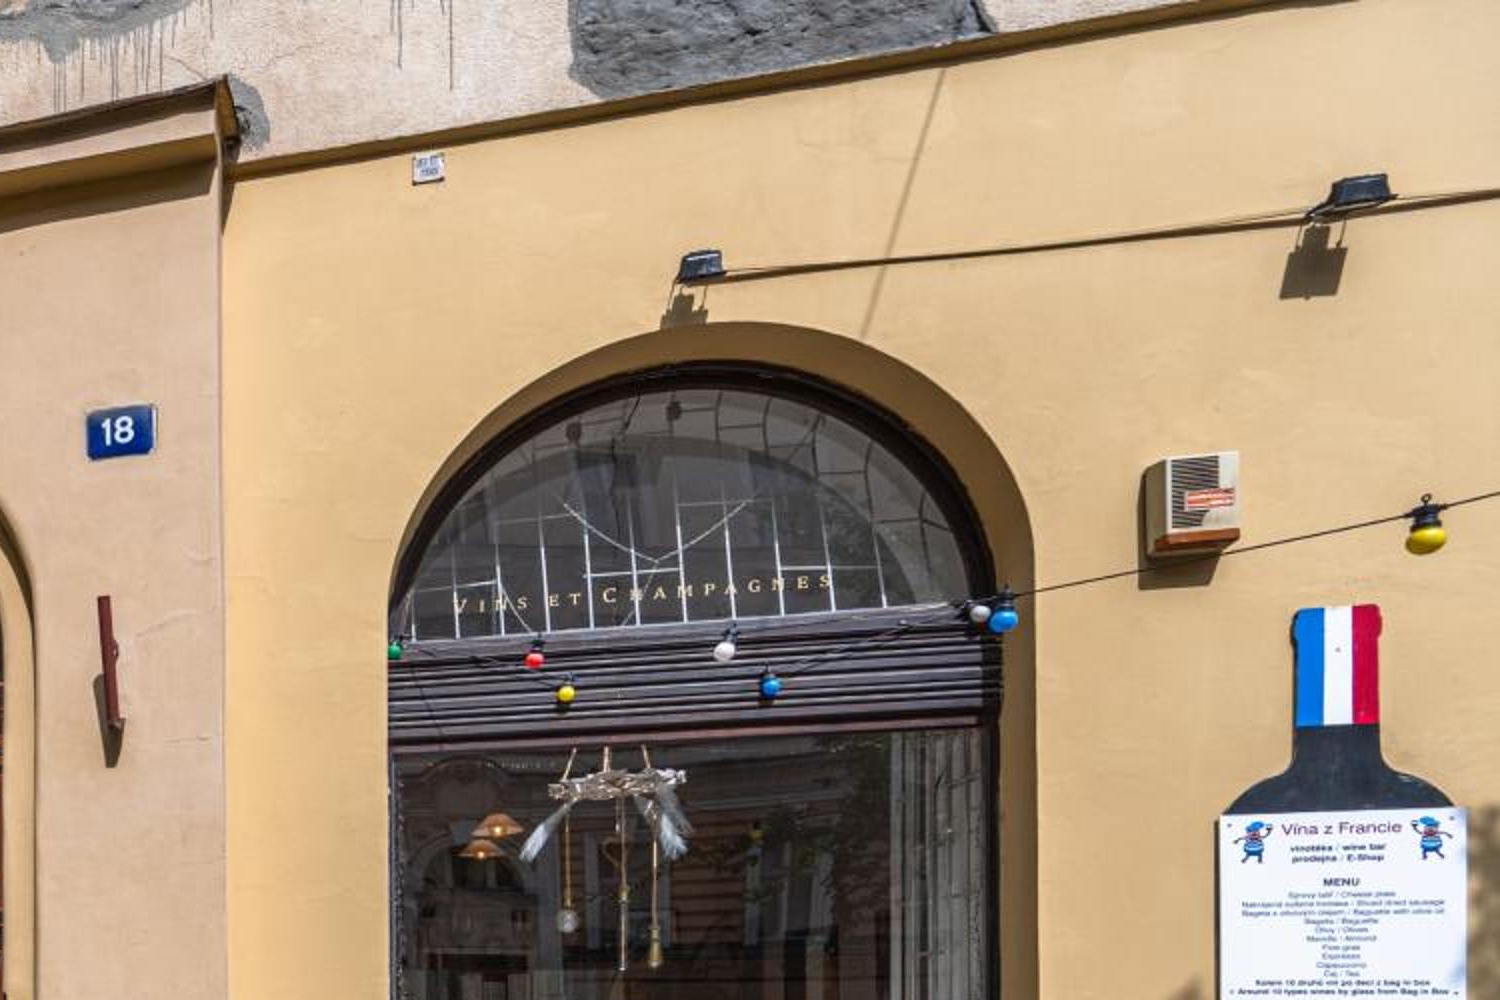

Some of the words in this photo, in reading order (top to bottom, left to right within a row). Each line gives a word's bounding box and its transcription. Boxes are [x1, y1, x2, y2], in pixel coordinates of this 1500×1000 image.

[101, 415, 135, 447] 18
[454, 593, 527, 614] VINS
[547, 593, 581, 608] ET
[602, 575, 831, 604] CHAMPAGNES
[1281, 822, 1319, 836] Vína
[1323, 824, 1333, 835] z
[1339, 820, 1403, 835] Francie
[1323, 877, 1361, 887] MENU
